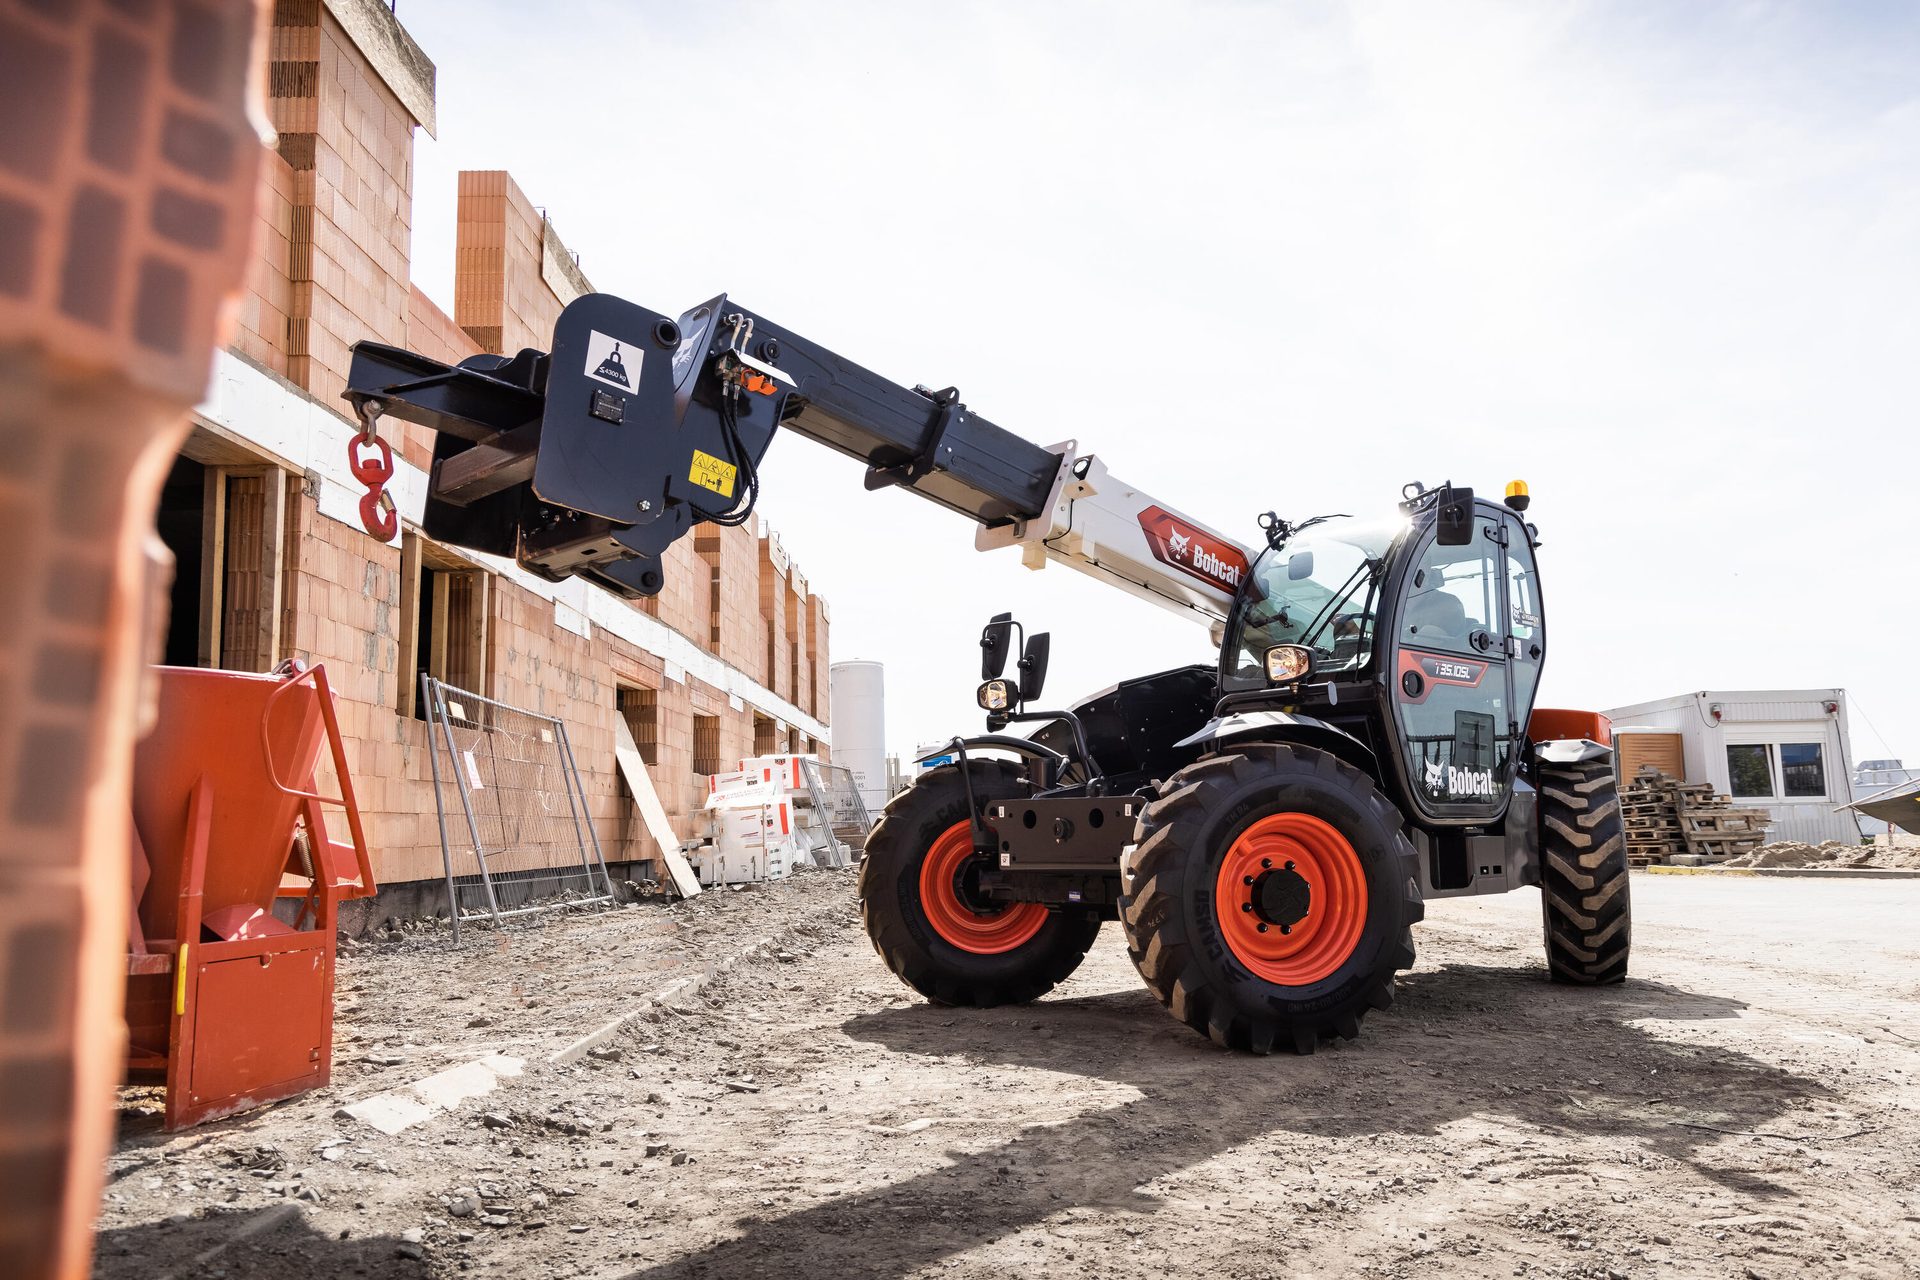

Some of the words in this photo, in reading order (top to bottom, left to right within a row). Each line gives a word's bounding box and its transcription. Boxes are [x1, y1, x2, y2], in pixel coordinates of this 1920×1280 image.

[619, 374, 627, 382] kg
[1193, 544, 1240, 587] Bobcat
[1448, 765, 1493, 795] Bobcat
